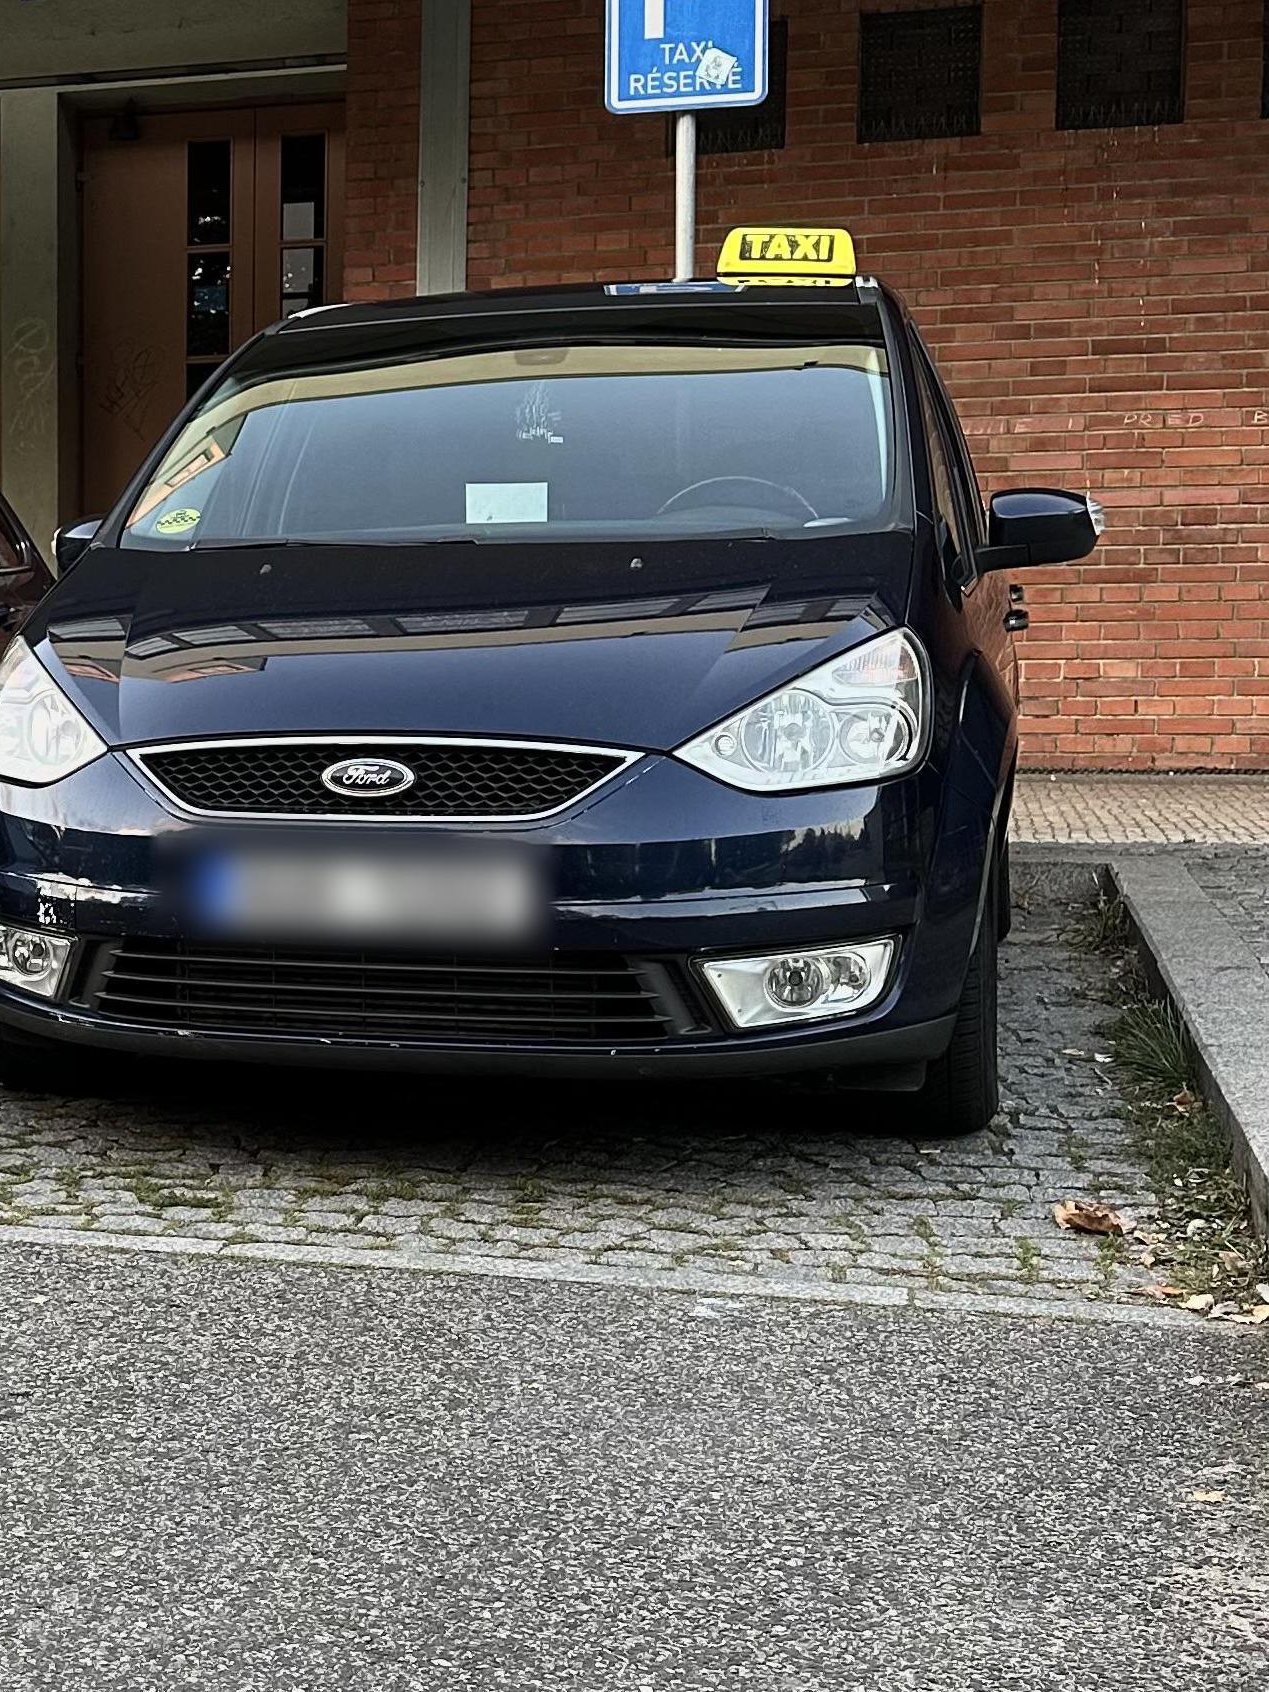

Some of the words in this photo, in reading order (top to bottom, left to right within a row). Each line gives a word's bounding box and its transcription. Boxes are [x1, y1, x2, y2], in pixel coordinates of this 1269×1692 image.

[629, 63, 743, 96] RÉSERÉ
[745, 234, 831, 260] TAXI
[342, 764, 392, 785] Ford
